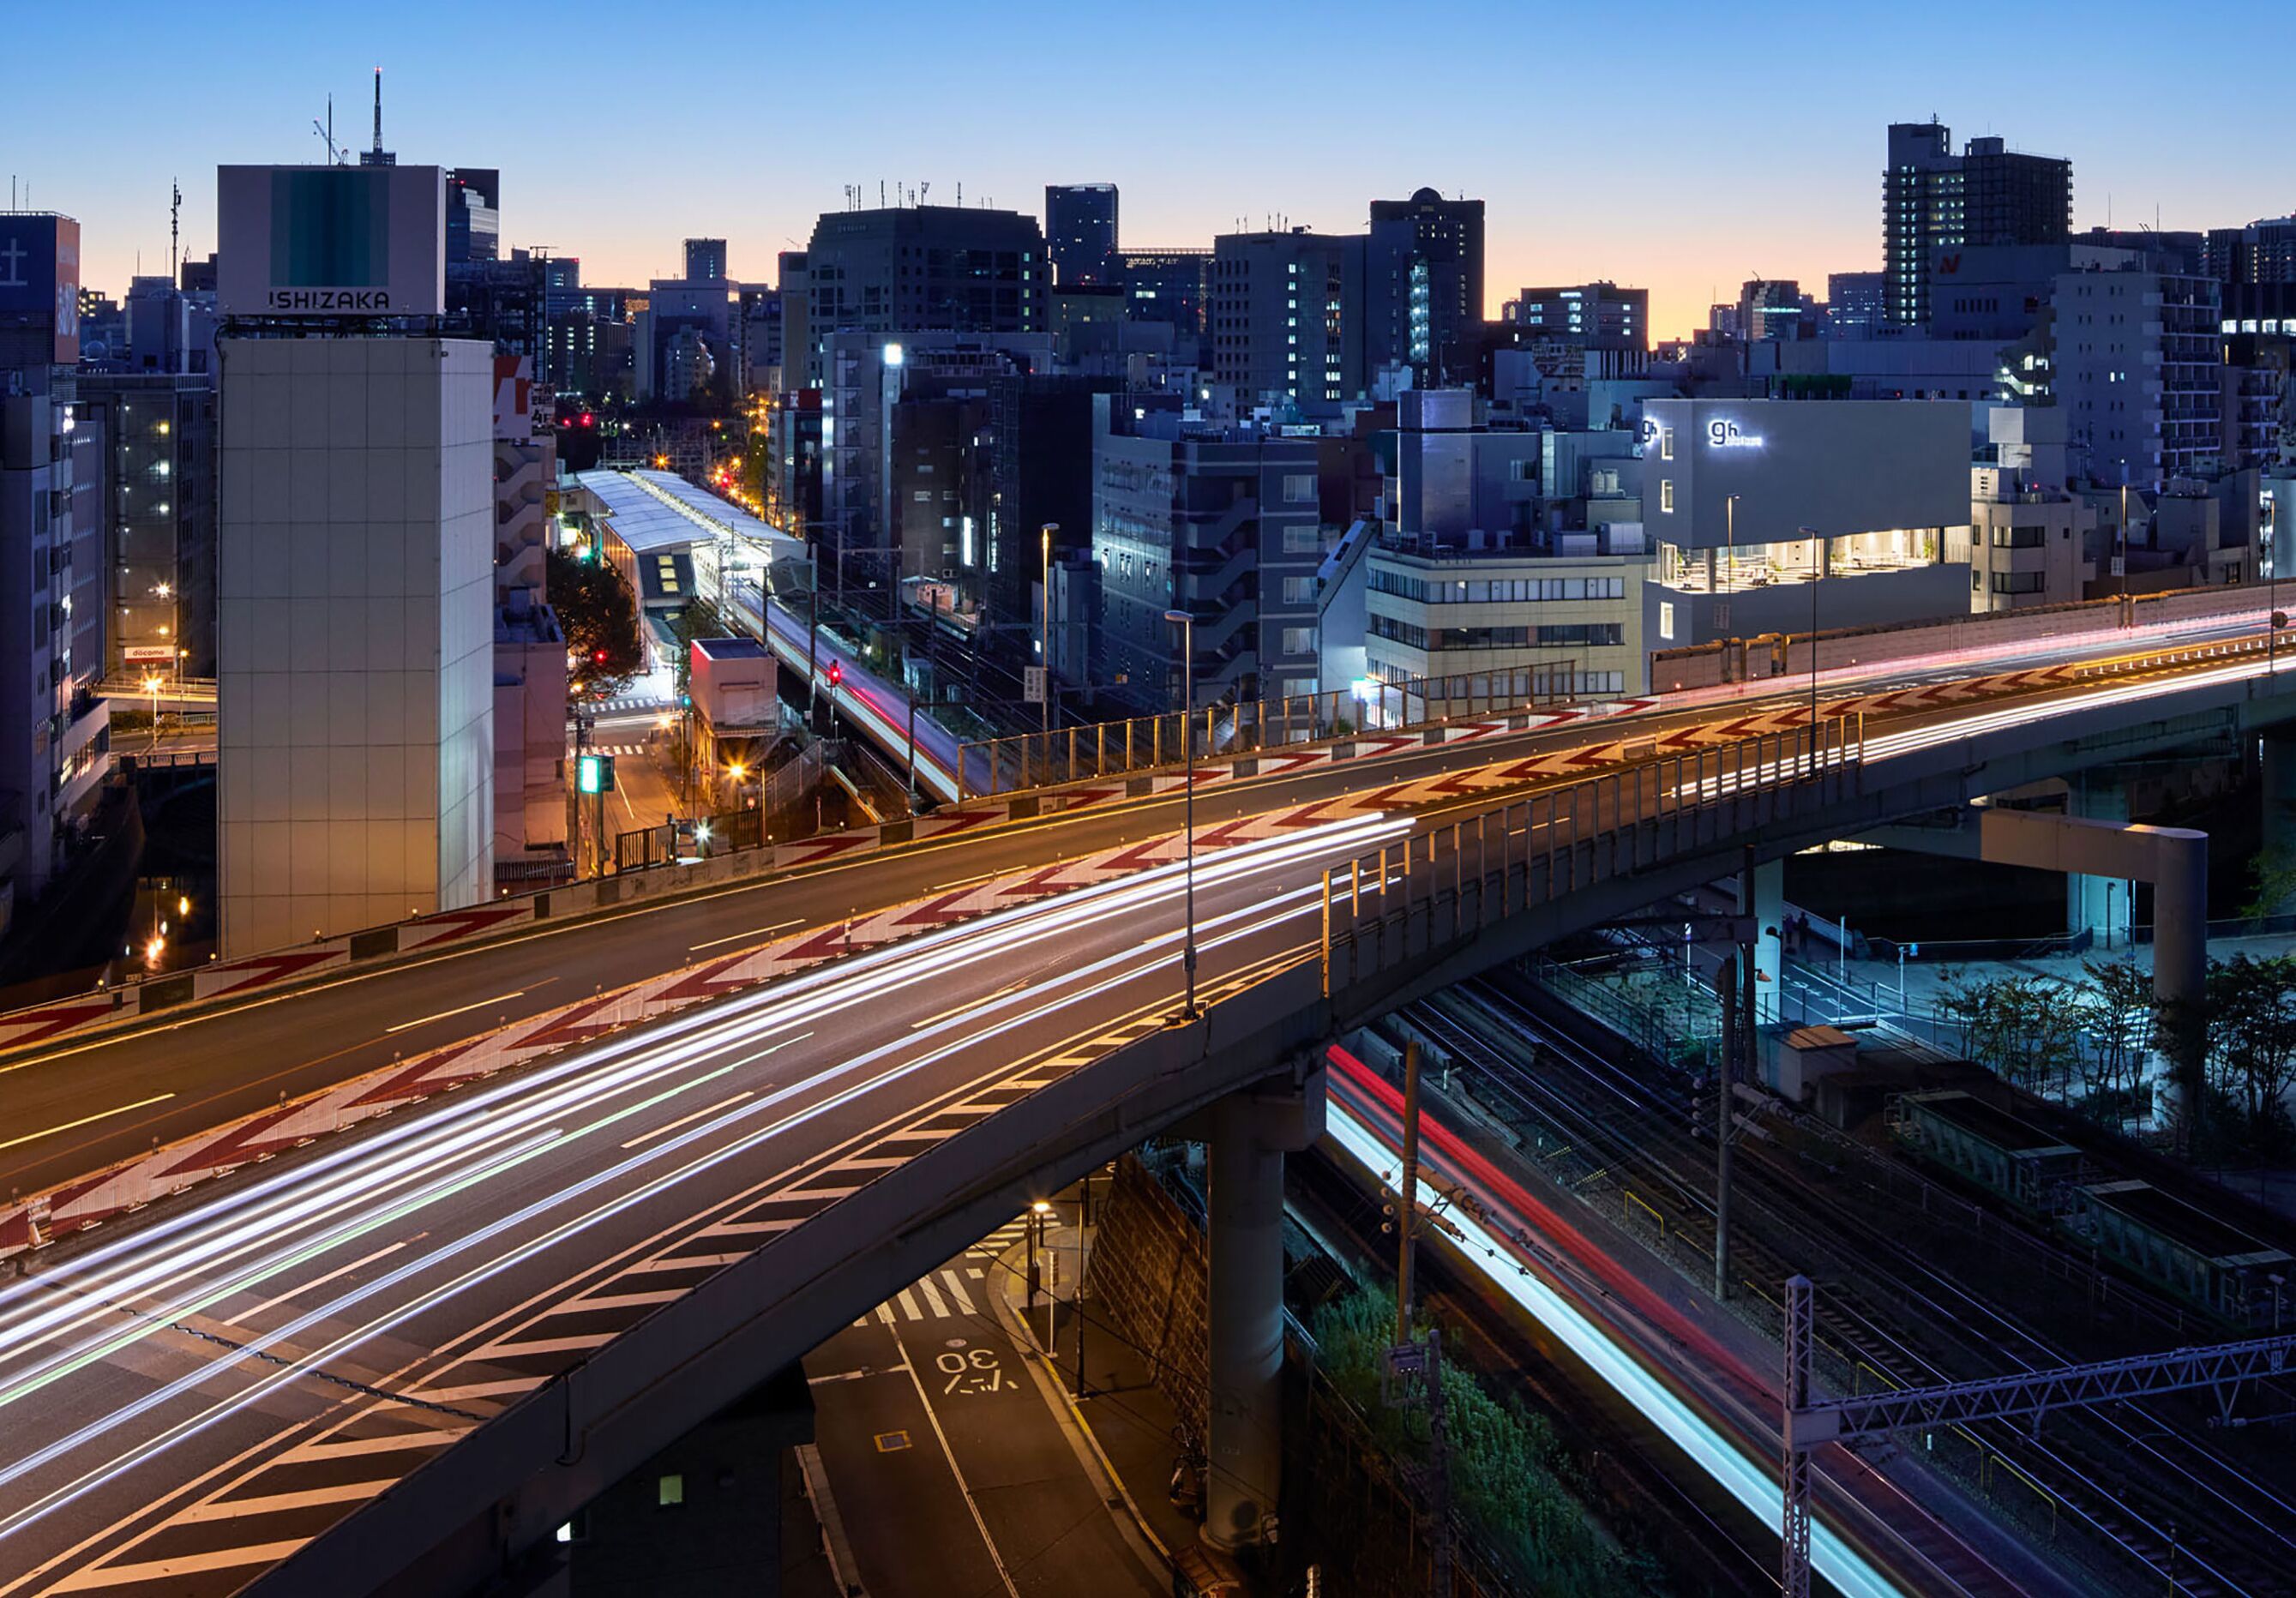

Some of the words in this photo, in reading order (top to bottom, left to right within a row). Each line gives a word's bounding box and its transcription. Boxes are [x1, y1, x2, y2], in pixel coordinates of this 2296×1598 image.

[269, 291, 389, 309] ISHIZAKA
[1711, 422, 1738, 445] gh
[935, 1349, 999, 1373] 30
